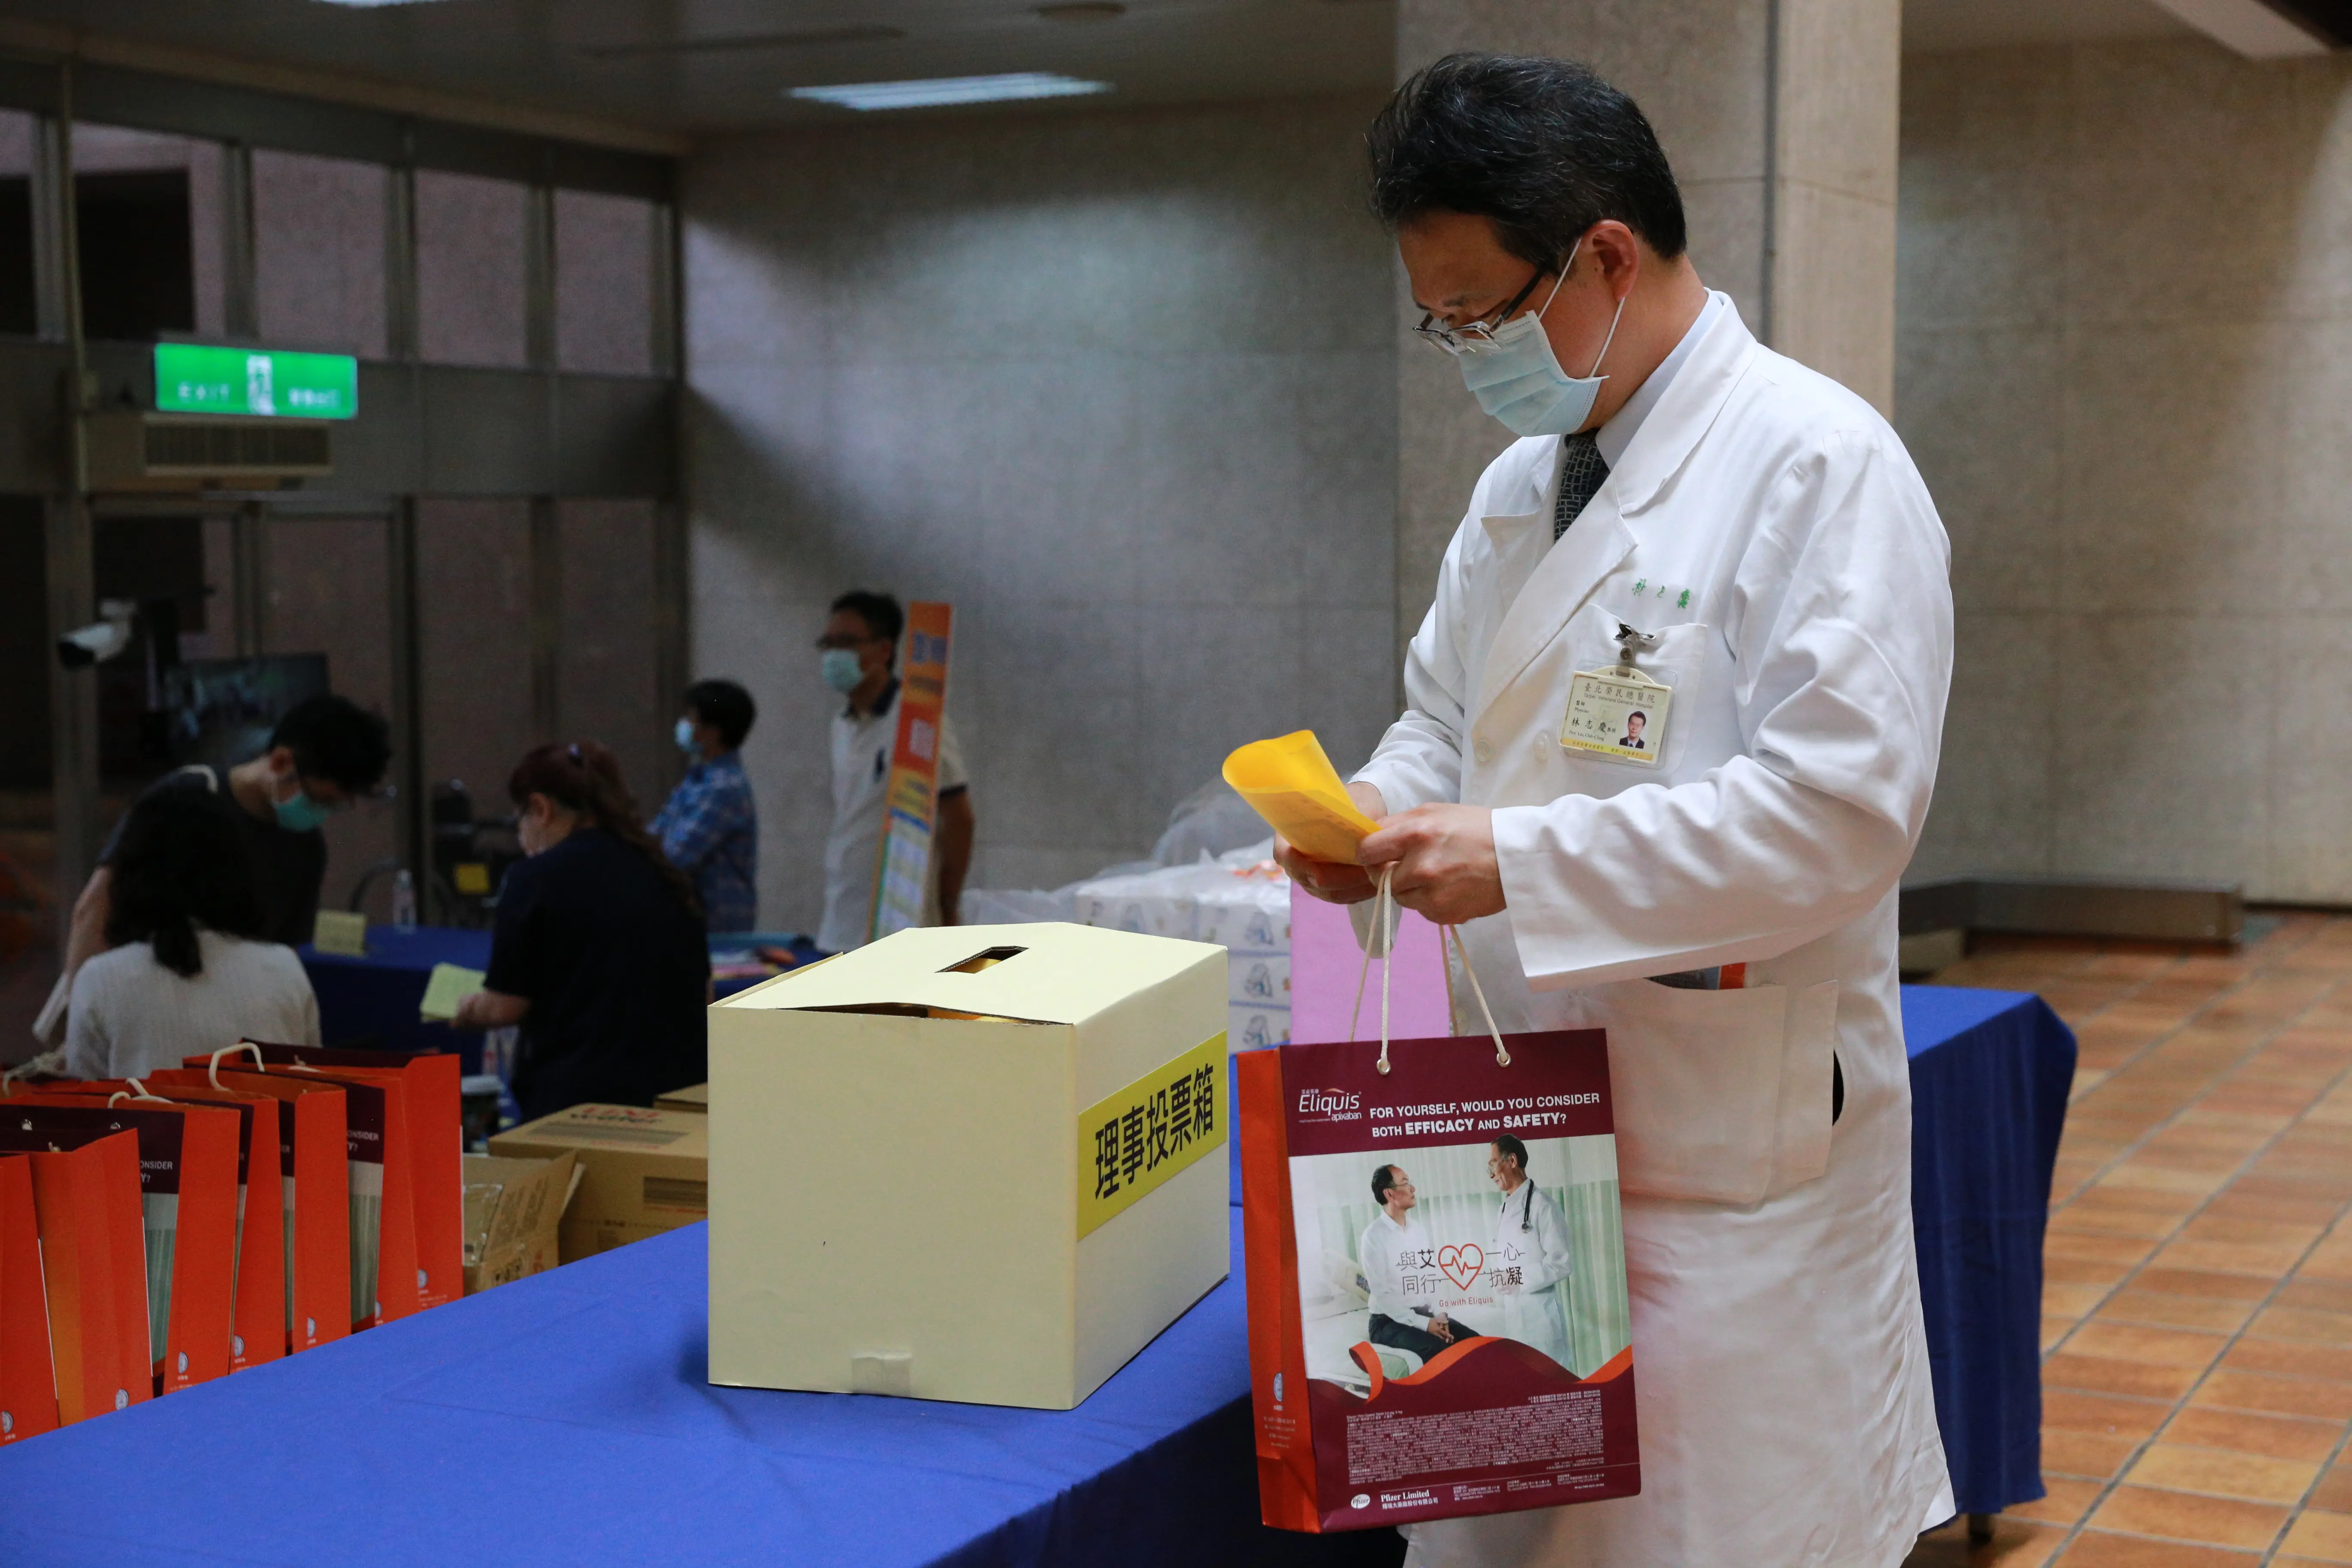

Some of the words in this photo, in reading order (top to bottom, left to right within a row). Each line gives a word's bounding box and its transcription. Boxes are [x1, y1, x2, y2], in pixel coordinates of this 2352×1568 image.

[1584, 683, 1655, 703] 臺北榮民總醫院
[1571, 717, 1606, 732] 林志慶
[1299, 1093, 1360, 1116] Eliquis
[1370, 1107, 1394, 1118] FOR
[1396, 1102, 1459, 1117] YOURSELF,
[1461, 1100, 1504, 1112] WOULD
[1507, 1097, 1533, 1109] YOU
[1537, 1093, 1600, 1107] CONSIDER
[1331, 1111, 1362, 1122] apixaban
[1372, 1126, 1402, 1137] BOTH
[1405, 1118, 1474, 1135] EFFICACY
[1478, 1119, 1500, 1130] AND
[1504, 1112, 1566, 1128] SAFETY?
[1095, 1063, 1213, 1200] 理事投票箱
[1397, 1249, 1436, 1271] 與艾
[1485, 1243, 1525, 1262] 一心
[1402, 1274, 1438, 1295] 同行
[1489, 1266, 1524, 1287] 抗凝
[1451, 1298, 1466, 1306] with
[1468, 1296, 1493, 1305] Eliquis
[1381, 1493, 1401, 1502] Pfizer
[1403, 1489, 1430, 1500] Limited
